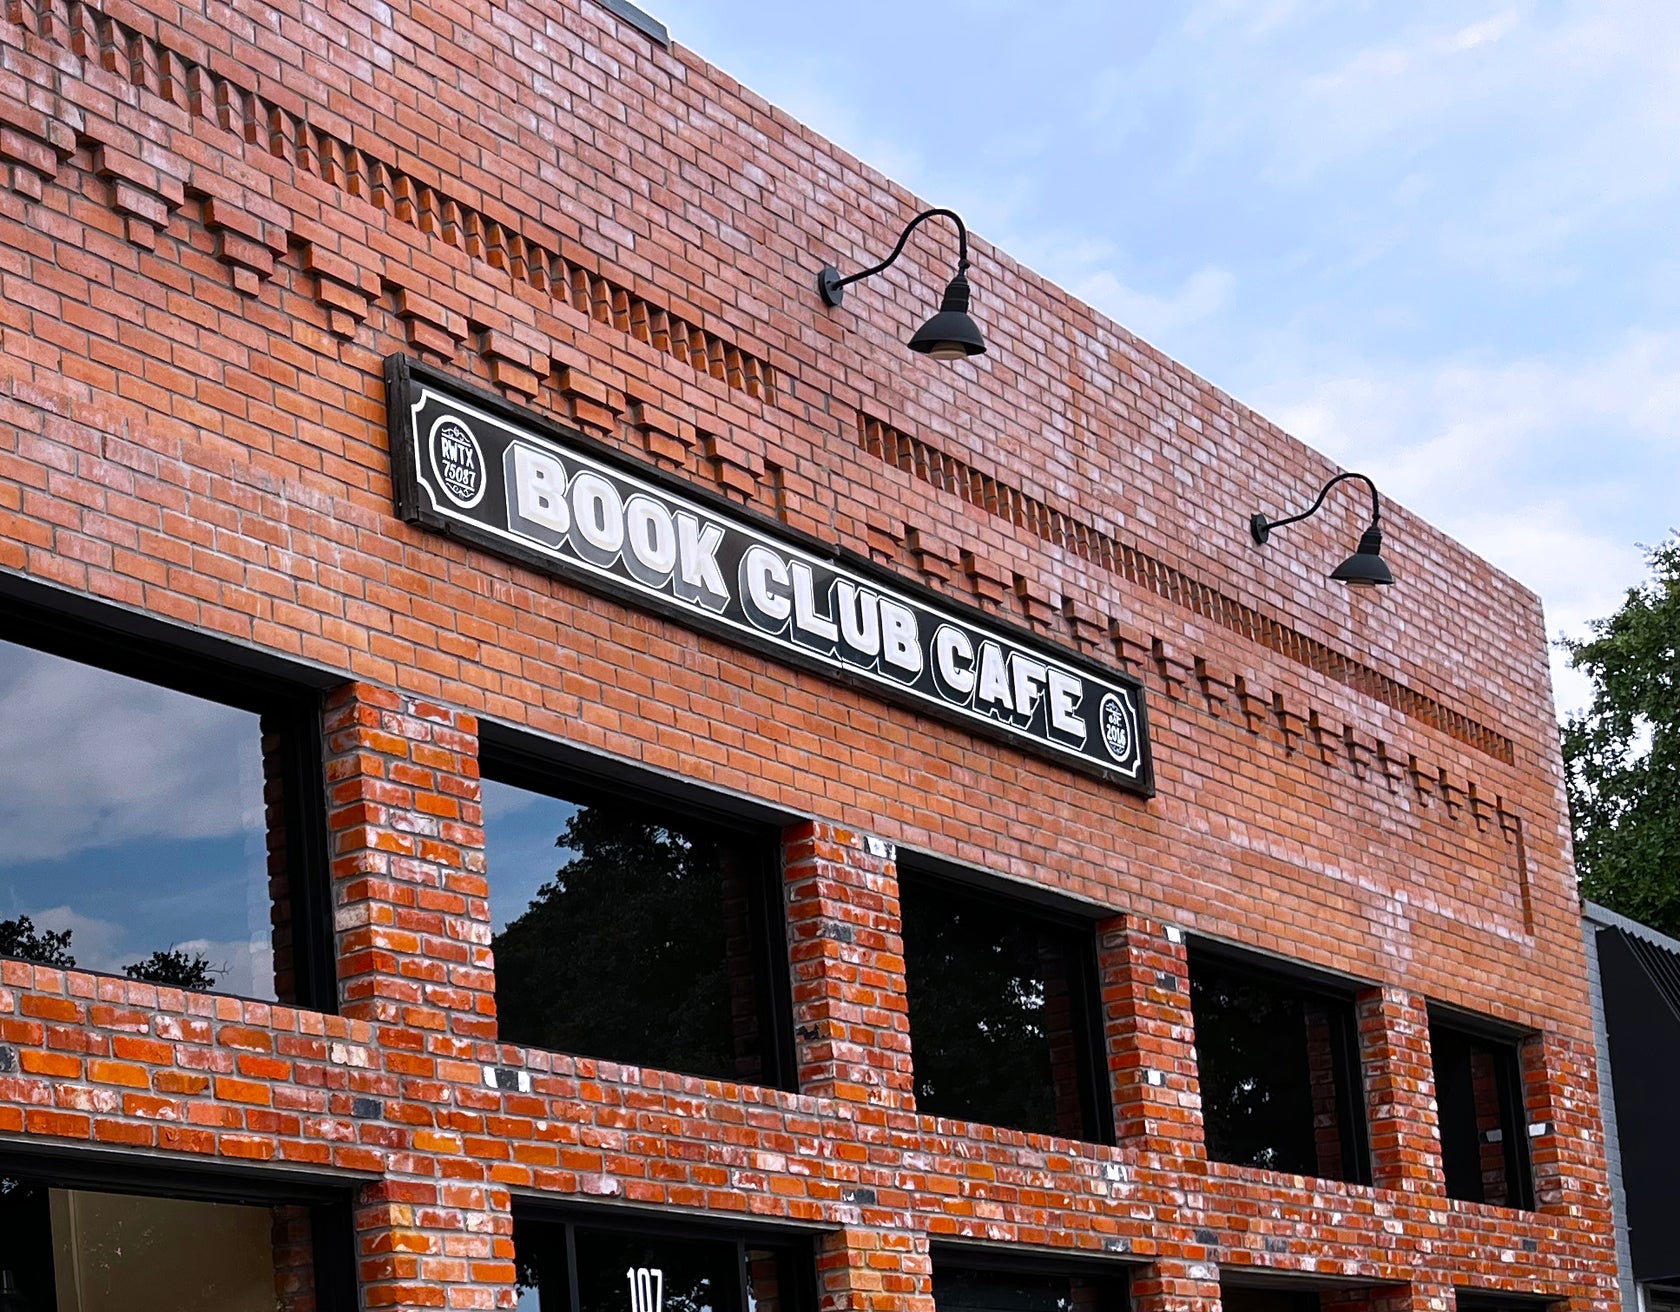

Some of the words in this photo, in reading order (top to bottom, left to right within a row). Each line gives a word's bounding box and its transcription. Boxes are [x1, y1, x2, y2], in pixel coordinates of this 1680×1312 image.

[441, 436, 474, 470] RWTX
[442, 460, 476, 488] 75087
[503, 440, 731, 614] BOOK
[738, 545, 923, 686] CLUB
[931, 623, 1087, 751] CAFE
